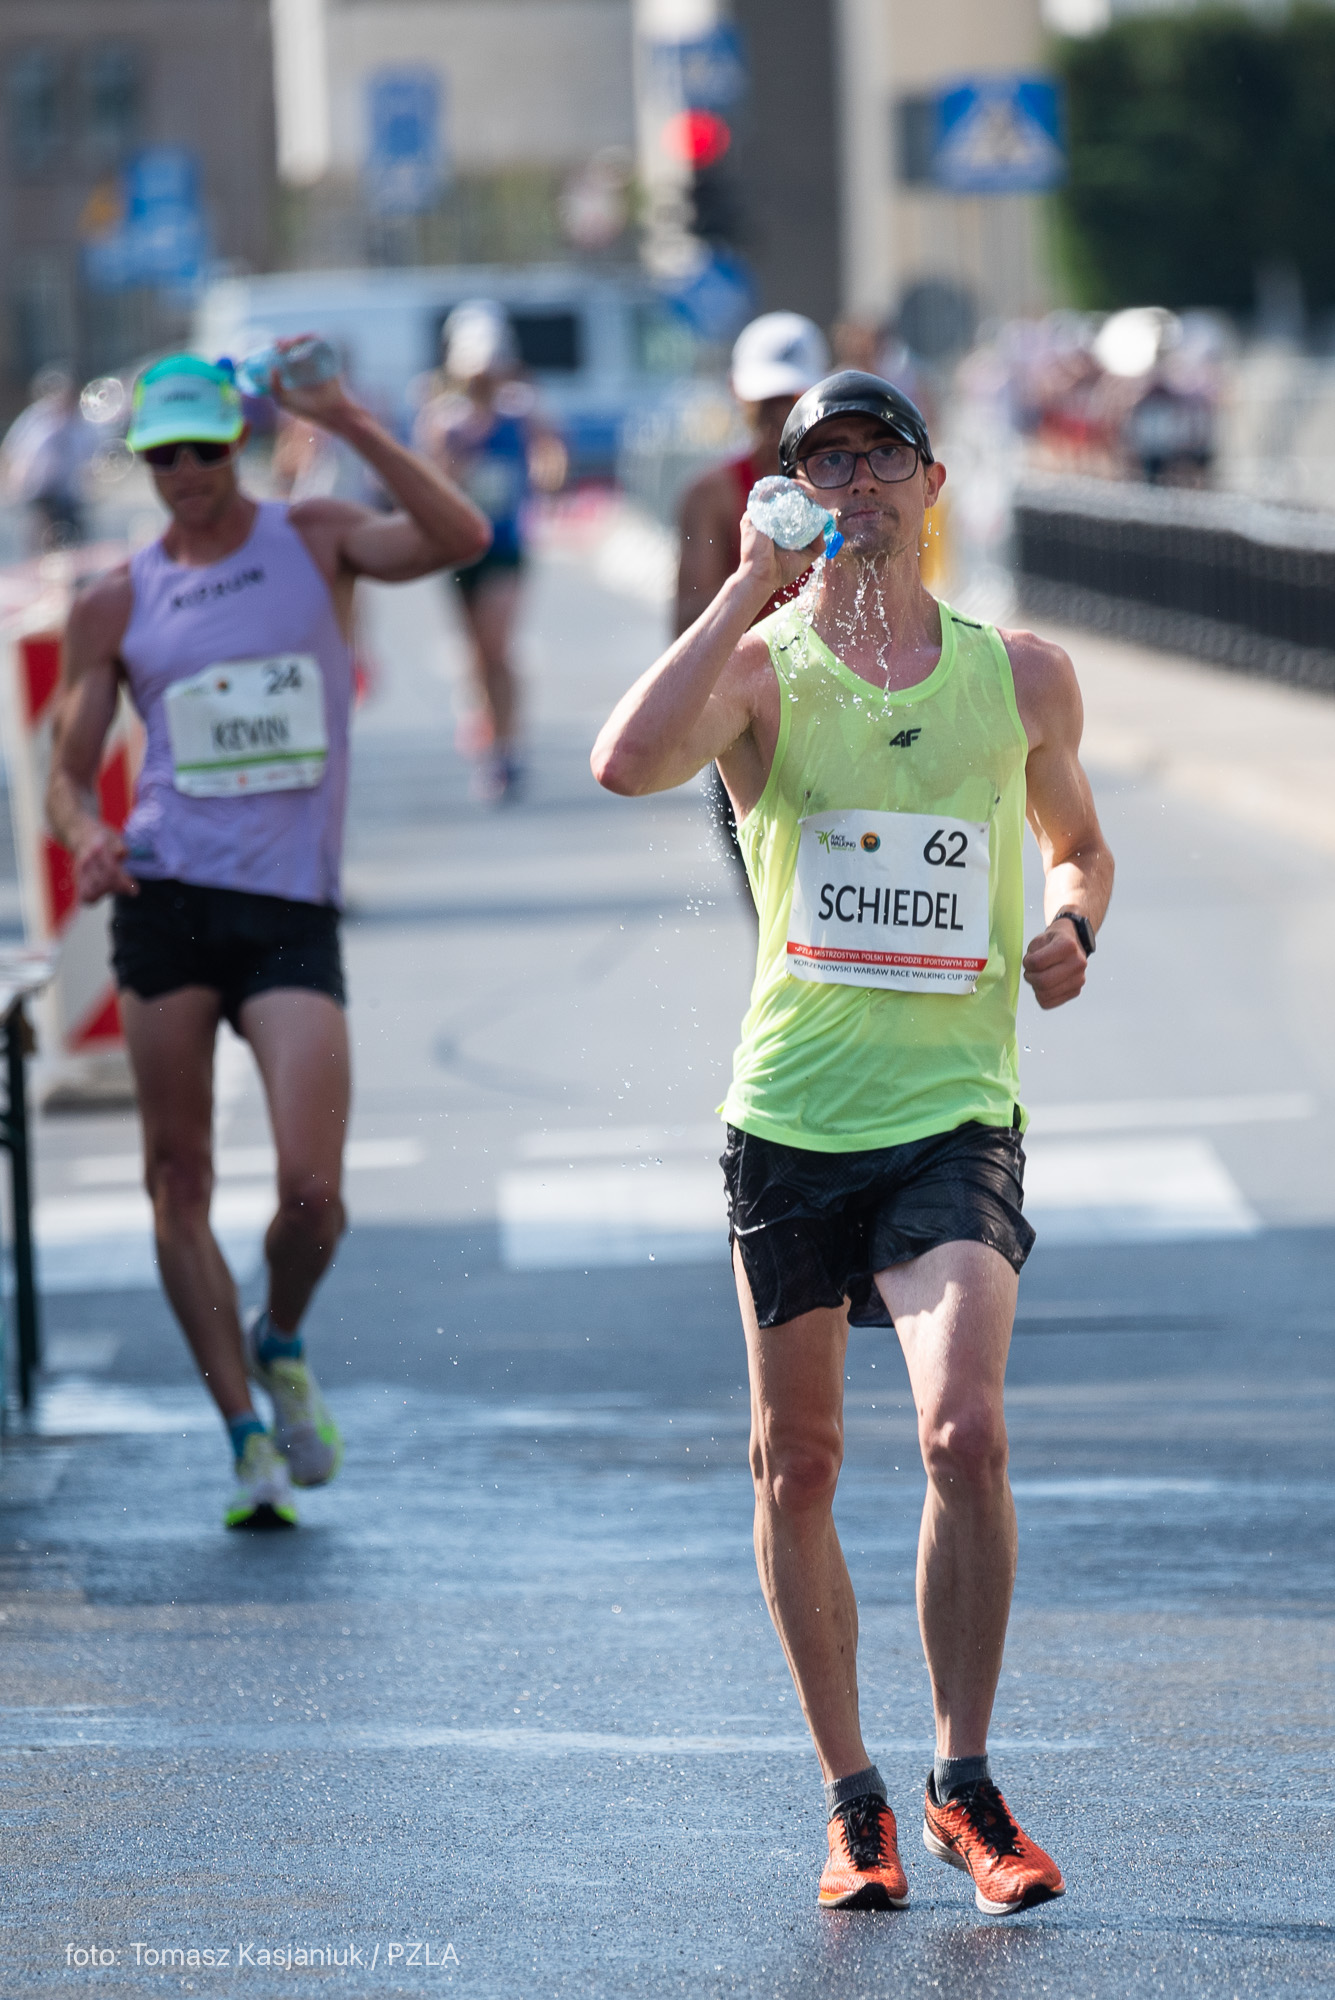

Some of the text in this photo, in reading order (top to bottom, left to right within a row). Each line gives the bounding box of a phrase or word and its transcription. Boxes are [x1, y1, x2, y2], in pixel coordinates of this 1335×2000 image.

[264, 663, 303, 696] 24
[211, 715, 290, 752] KEVIN
[889, 728, 922, 748] 4F
[830, 834, 846, 842] RACE
[923, 829, 968, 868] 62
[818, 883, 964, 931] SCHIEDEL
[793, 959, 852, 974] KORZENIOWSKI
[853, 965, 889, 977] WARSAW
[890, 969, 910, 978] RACE
[911, 971, 946, 981] WALKING
[947, 973, 963, 981] CUP
[813, 949, 860, 960] MISTRZOSTWA
[861, 953, 884, 963] POLSKI
[885, 954, 893, 963] W
[893, 956, 922, 965] CHODZIE
[923, 957, 963, 967] SPORTOWYM
[963, 959, 979, 968] 2024
